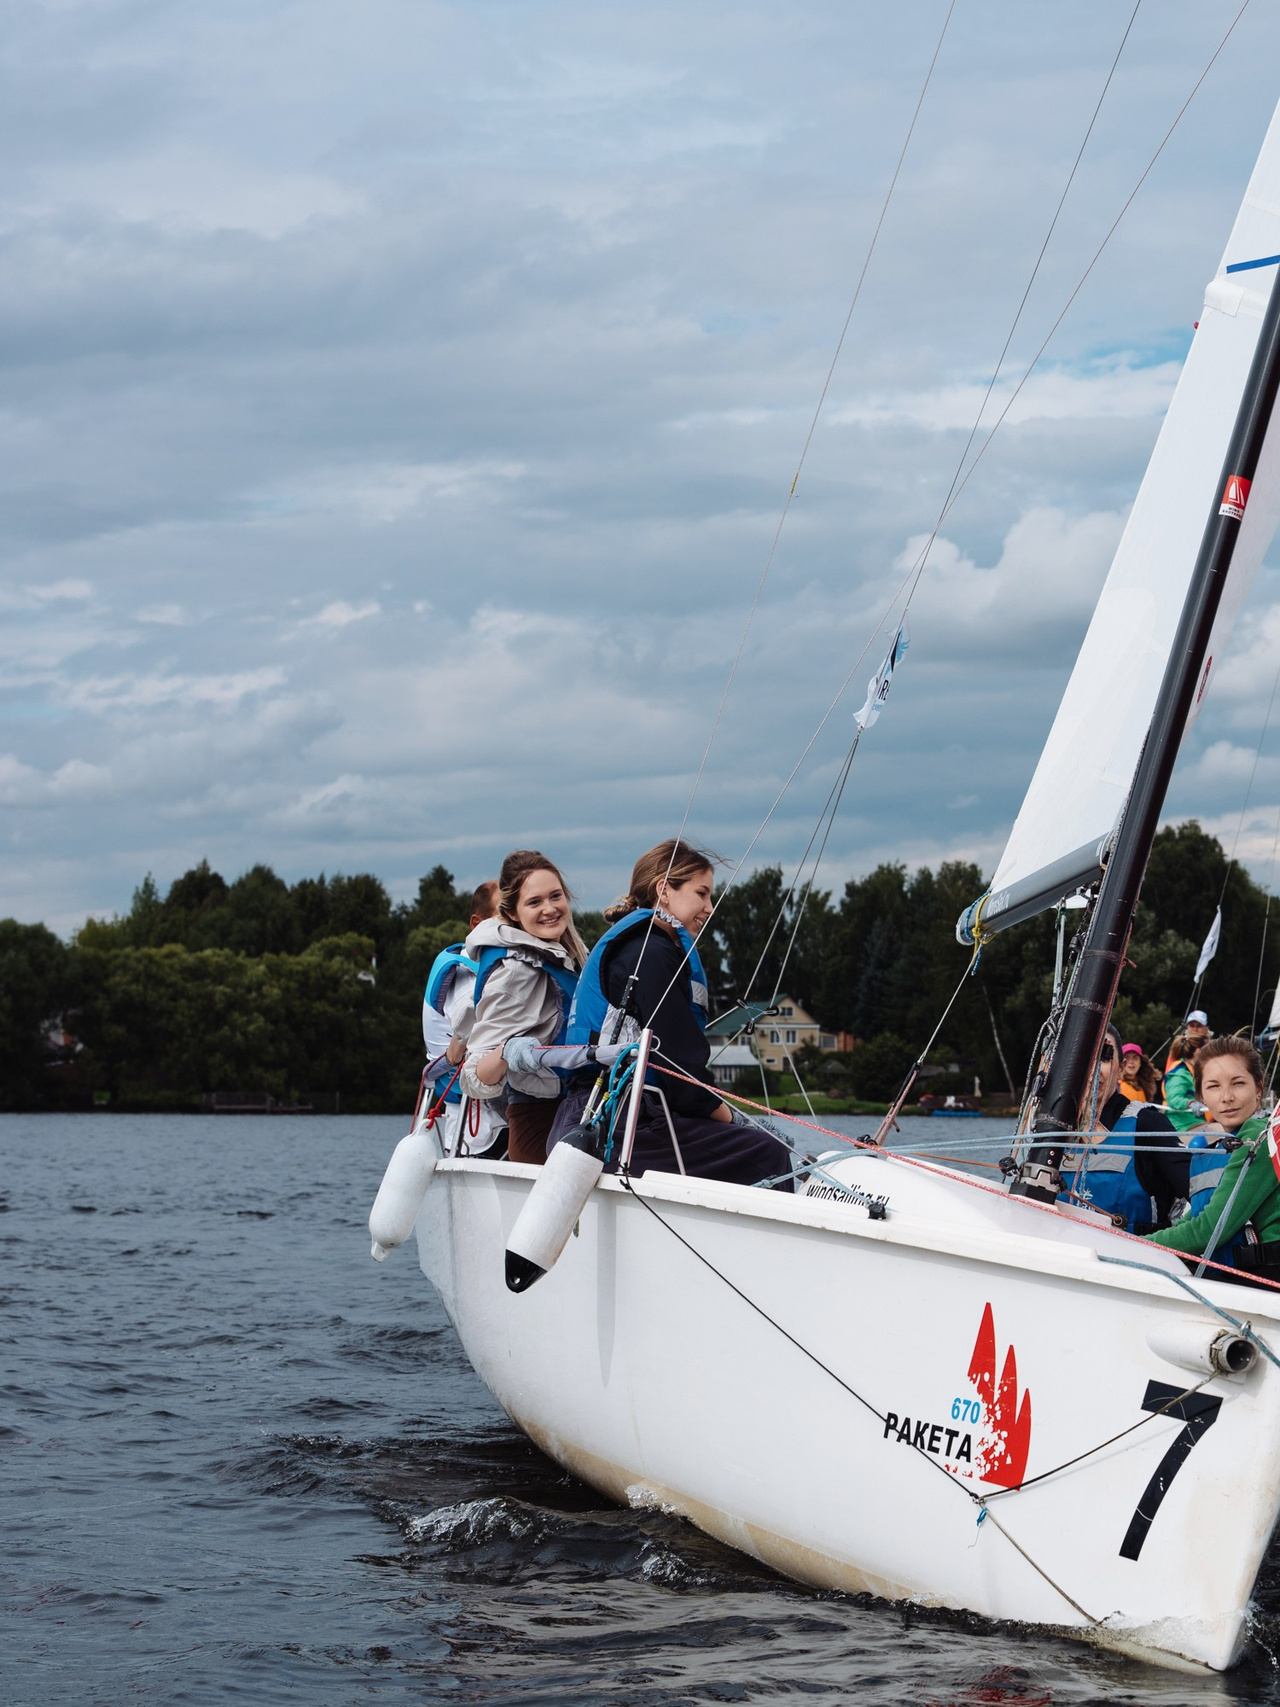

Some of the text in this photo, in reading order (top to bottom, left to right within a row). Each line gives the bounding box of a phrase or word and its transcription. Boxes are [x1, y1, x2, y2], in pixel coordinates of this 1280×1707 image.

[806, 1180, 890, 1207] windsailingru
[951, 1397, 981, 1425] 670
[1119, 1379, 1223, 1561] 7
